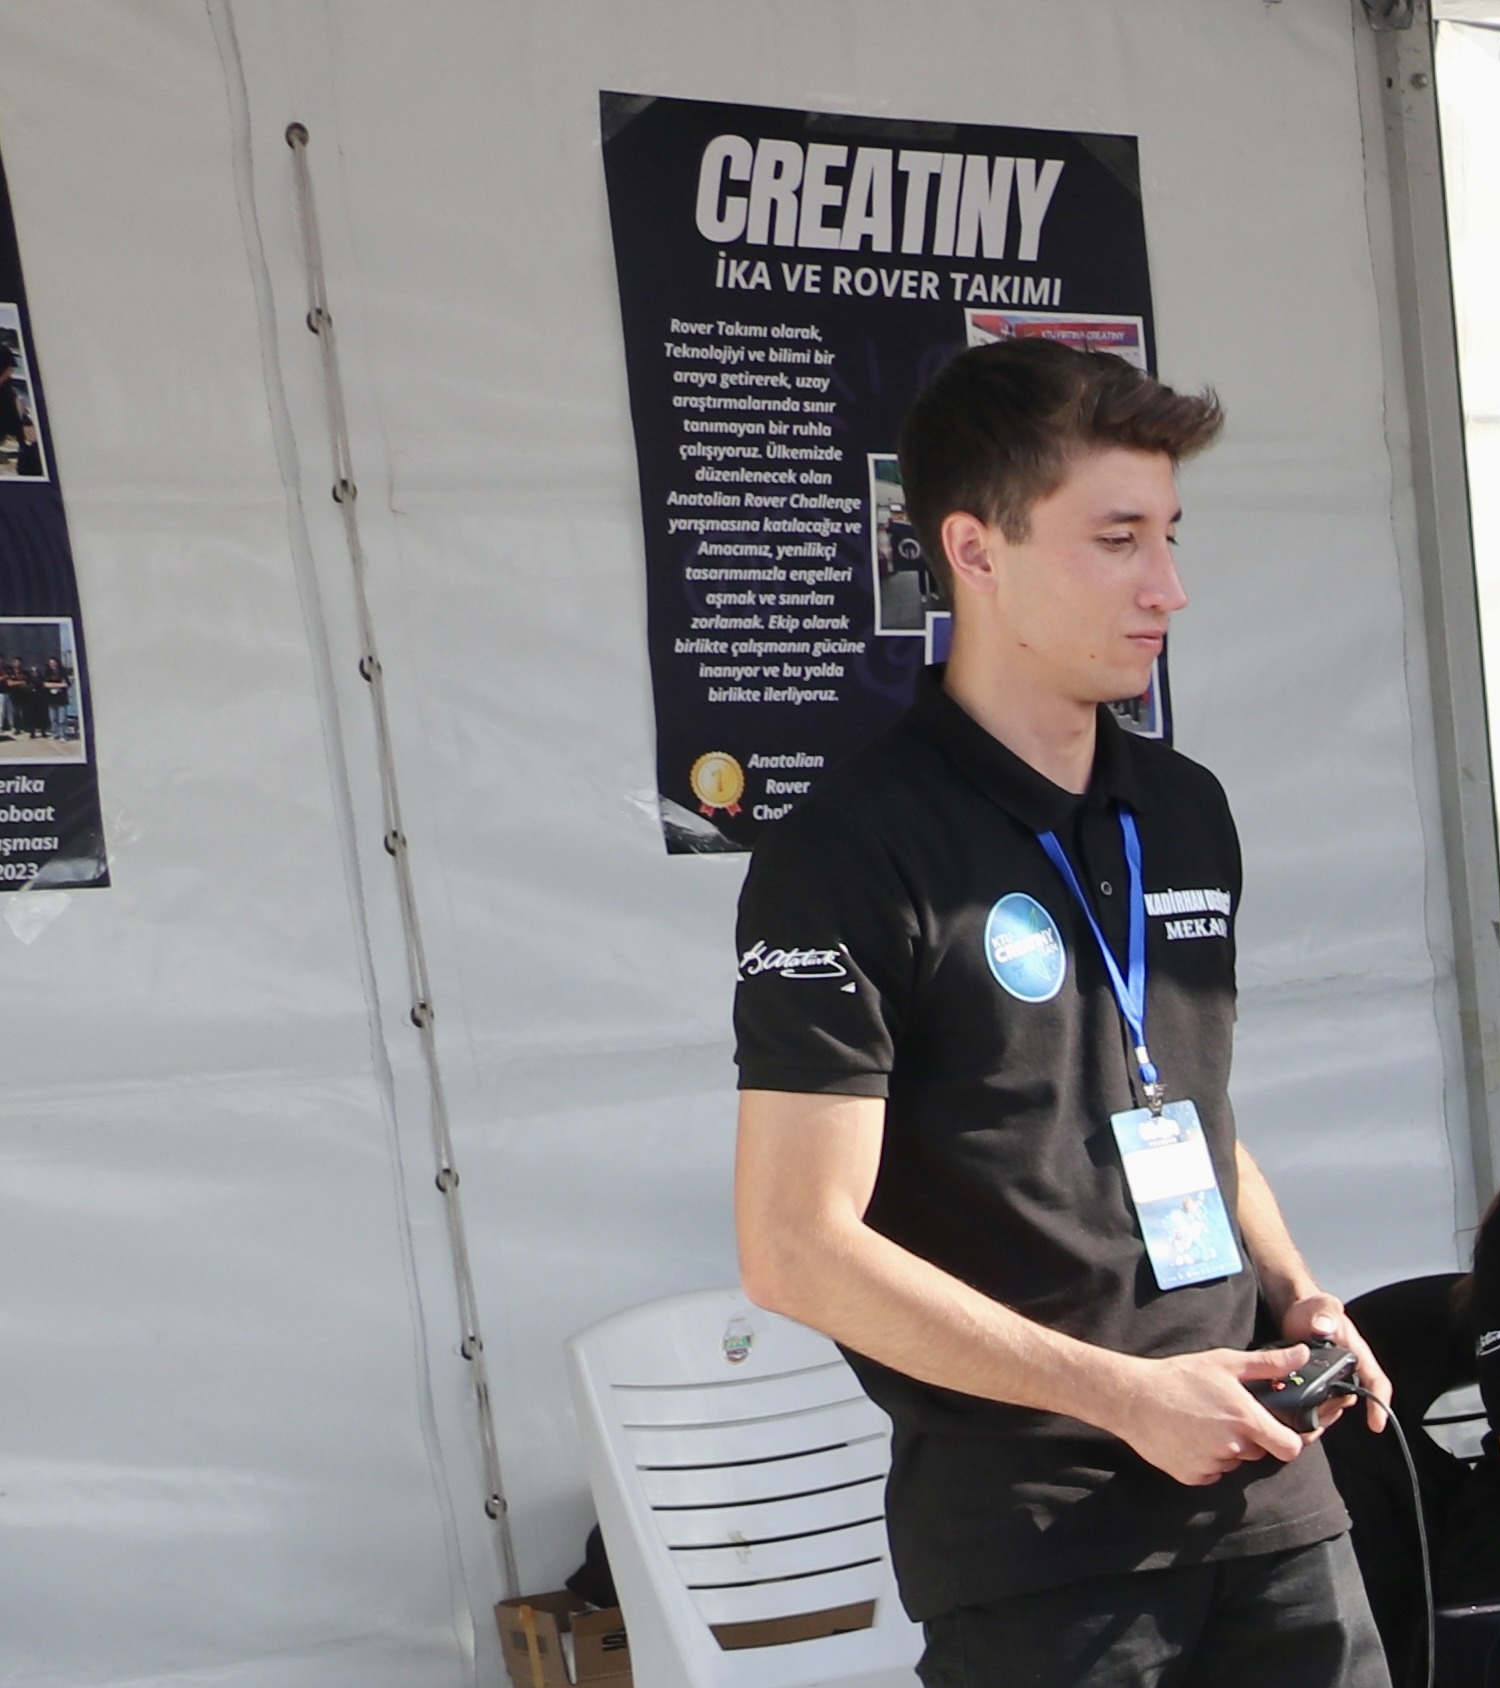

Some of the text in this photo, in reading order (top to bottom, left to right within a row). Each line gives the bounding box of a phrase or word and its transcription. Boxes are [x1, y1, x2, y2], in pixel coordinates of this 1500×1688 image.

[695, 133, 1065, 262] CREATINY
[716, 250, 1062, 307] İKA VE ROVER TAKIMI
[671, 318, 823, 343] Rover Takımı olarak,
[664, 341, 836, 366] Teknolojiyi ve bilimi bir
[672, 371, 831, 395] araya getirerek, uzay
[672, 393, 837, 416] araştırmalarında sınır
[683, 417, 832, 439] tanımayan bir ruhla
[679, 440, 844, 463] çalışıyoruz. Ülkemizde
[695, 466, 832, 485] düzenlenecek olan
[666, 490, 863, 514] Anatolian Rover Challenge
[668, 517, 863, 537] yarışmasına katılacağız ve
[697, 541, 837, 561] Amacımız, yenilikçi
[685, 566, 852, 587] tasarımımızla engelleri
[705, 591, 835, 609] aşmak ve sınırları
[691, 614, 850, 634] zorlamak. Ekip olarak
[674, 637, 866, 660] birlikte çalışmanın gücüne
[699, 662, 845, 682] inanıyor ve bu yolda
[708, 686, 840, 706] birlikte ilerliyoruz.
[747, 752, 825, 770] Anatolian
[765, 778, 811, 796] Rover
[752, 803, 794, 822] Chal
[0, 835, 59, 857] şması
[0, 862, 39, 881] 2023
[991, 931, 1013, 949] KTU
